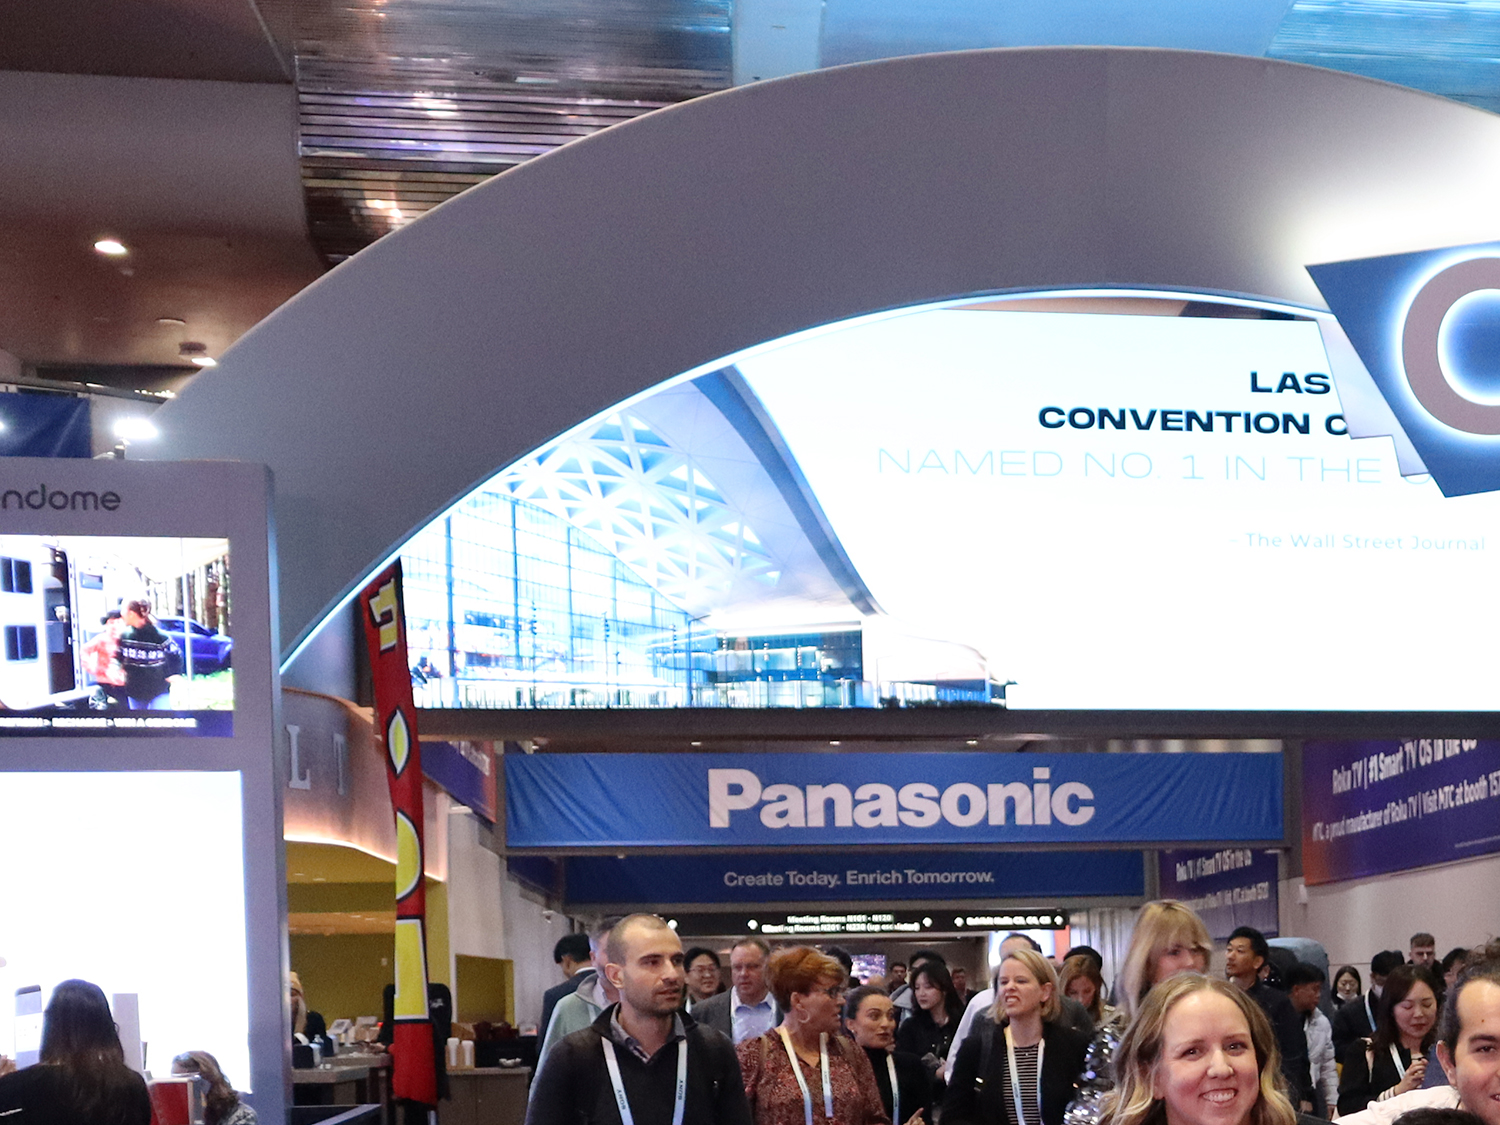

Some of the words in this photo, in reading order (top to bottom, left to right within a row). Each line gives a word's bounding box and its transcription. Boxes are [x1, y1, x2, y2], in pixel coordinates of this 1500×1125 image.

[1250, 371, 1331, 395] LAS
[1038, 405, 1310, 435] CONVENTION
[878, 447, 1063, 477] NAMED
[1085, 451, 1161, 479] NO.
[1181, 454, 1204, 480] 1
[1225, 455, 1266, 481] IN
[1286, 456, 1382, 484] THE
[1245, 532, 1282, 548] The
[1290, 533, 1335, 548] Wall
[1342, 534, 1403, 550] Street
[1410, 535, 1486, 551] Journal
[708, 767, 1095, 828] Panasonic
[723, 871, 783, 887] Create
[785, 870, 841, 887] Today.
[846, 870, 903, 886] Enrich
[904, 868, 995, 885] Tomorrow.
[787, 915, 819, 925] Meeting
[820, 915, 846, 924] Rooms
